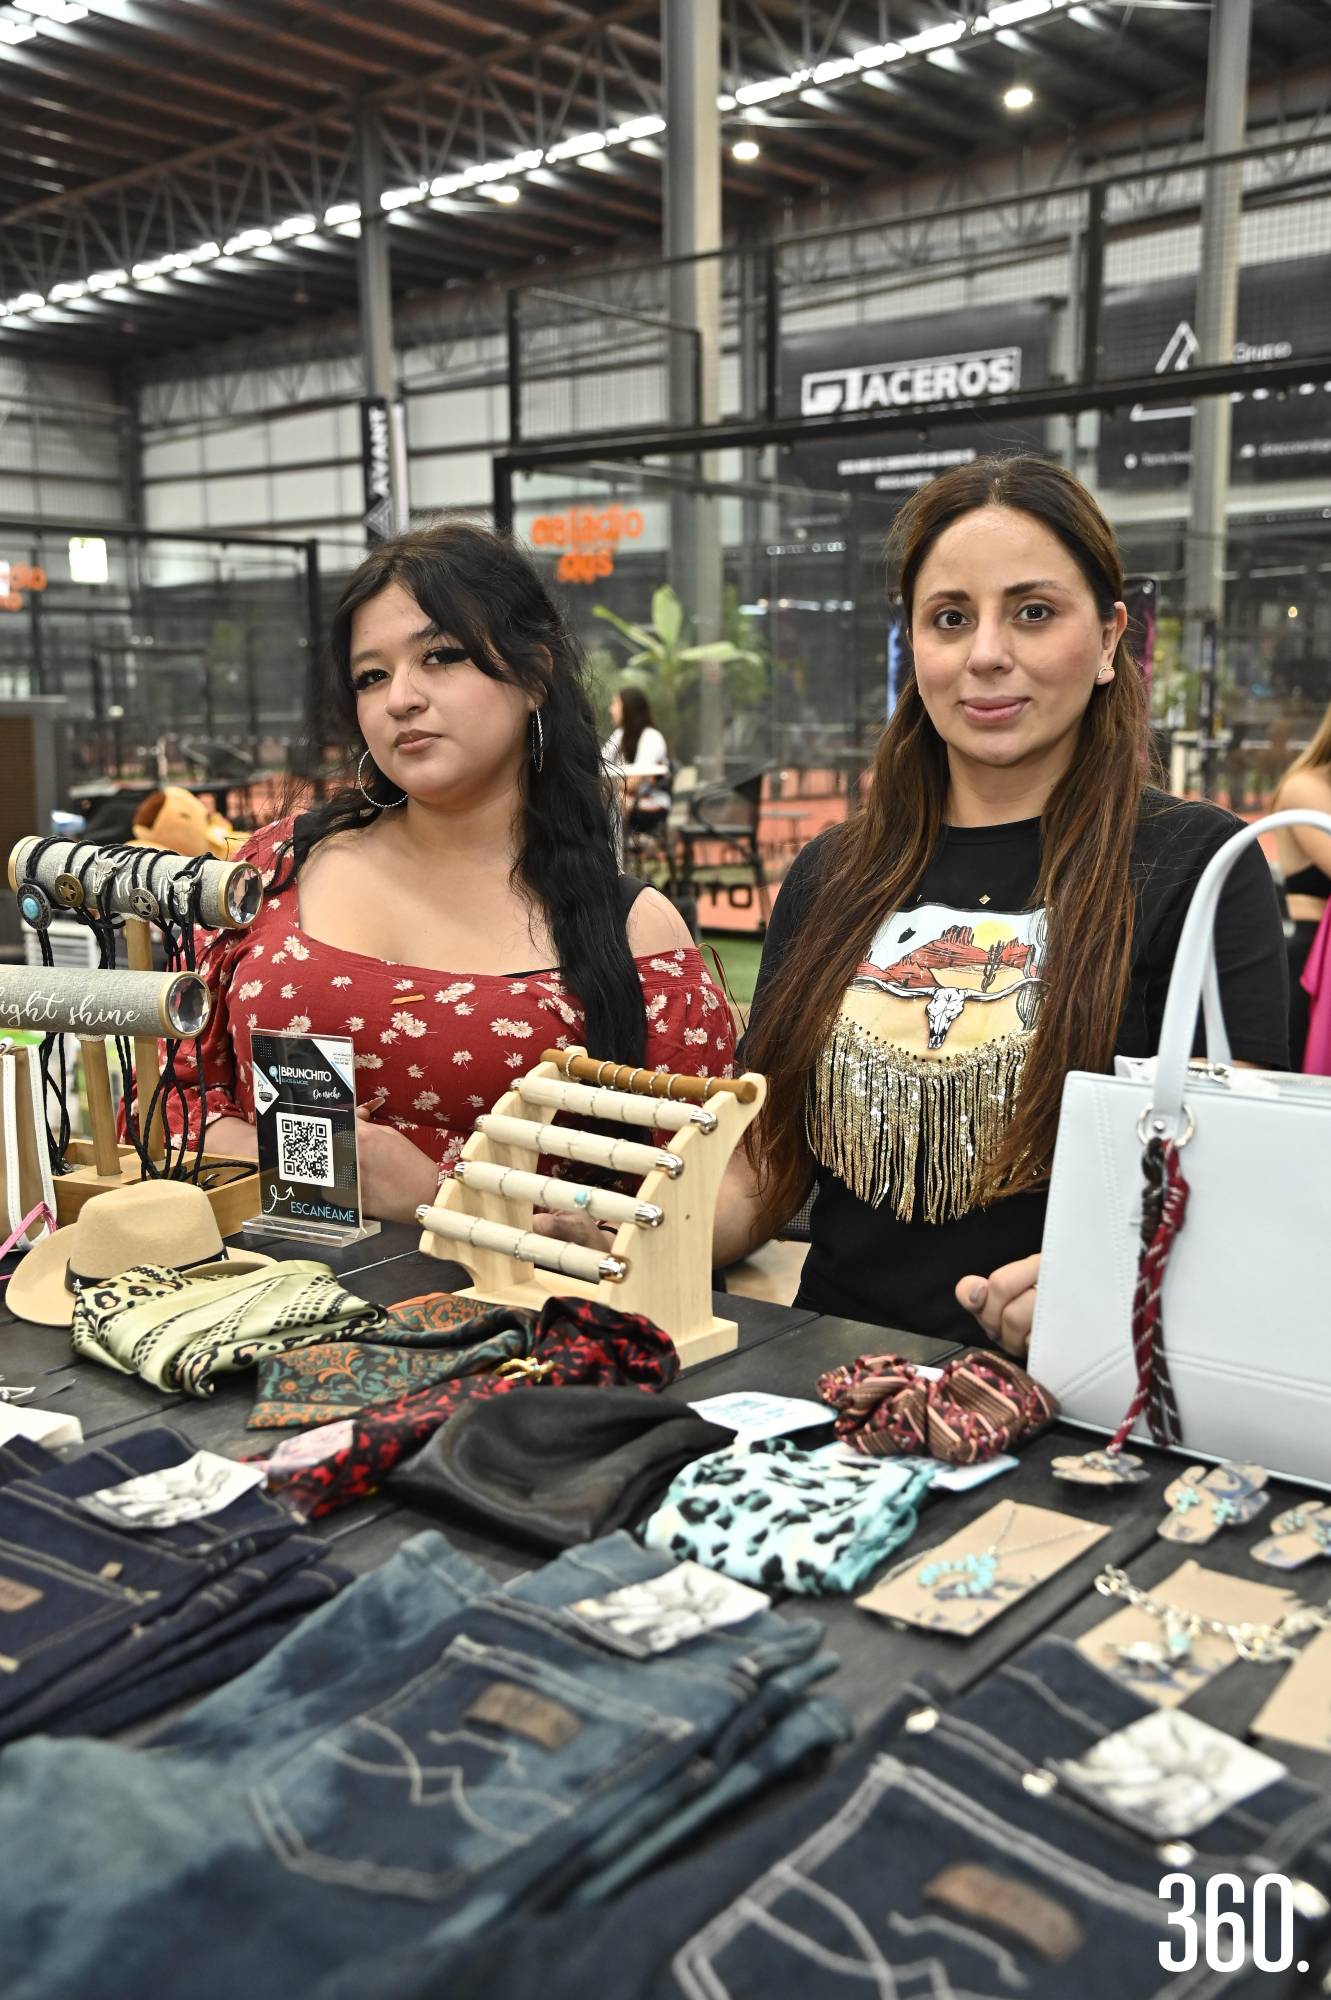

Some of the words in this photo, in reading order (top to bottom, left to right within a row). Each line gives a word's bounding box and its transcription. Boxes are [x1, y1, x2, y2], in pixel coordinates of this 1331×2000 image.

[69, 994, 140, 1026] shine
[280, 1066, 332, 1082] BRUNCHITO
[290, 1201, 355, 1222] ESCANÉAME
